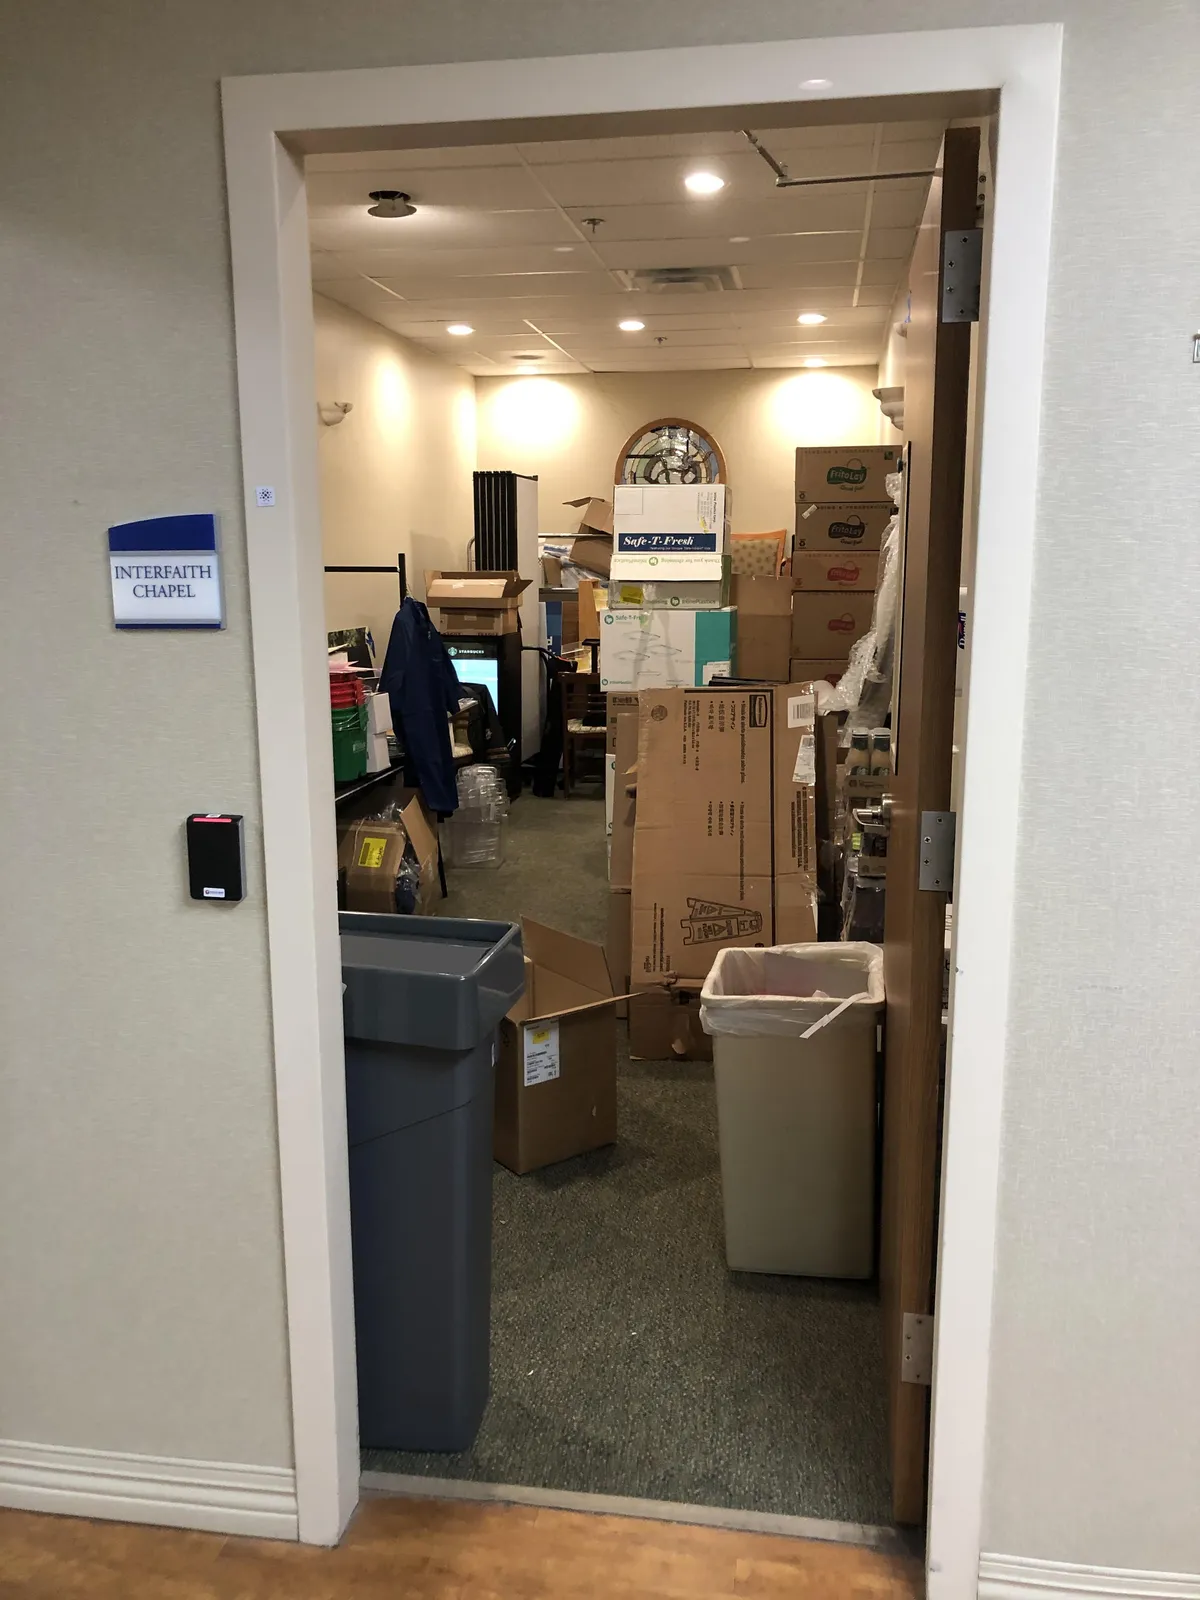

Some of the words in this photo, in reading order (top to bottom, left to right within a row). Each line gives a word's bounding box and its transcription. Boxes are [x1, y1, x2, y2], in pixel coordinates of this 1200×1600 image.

[623, 536, 694, 548] Safe-T-Fresh
[115, 565, 212, 579] INTERFAITH
[132, 584, 196, 598] CHAPEL
